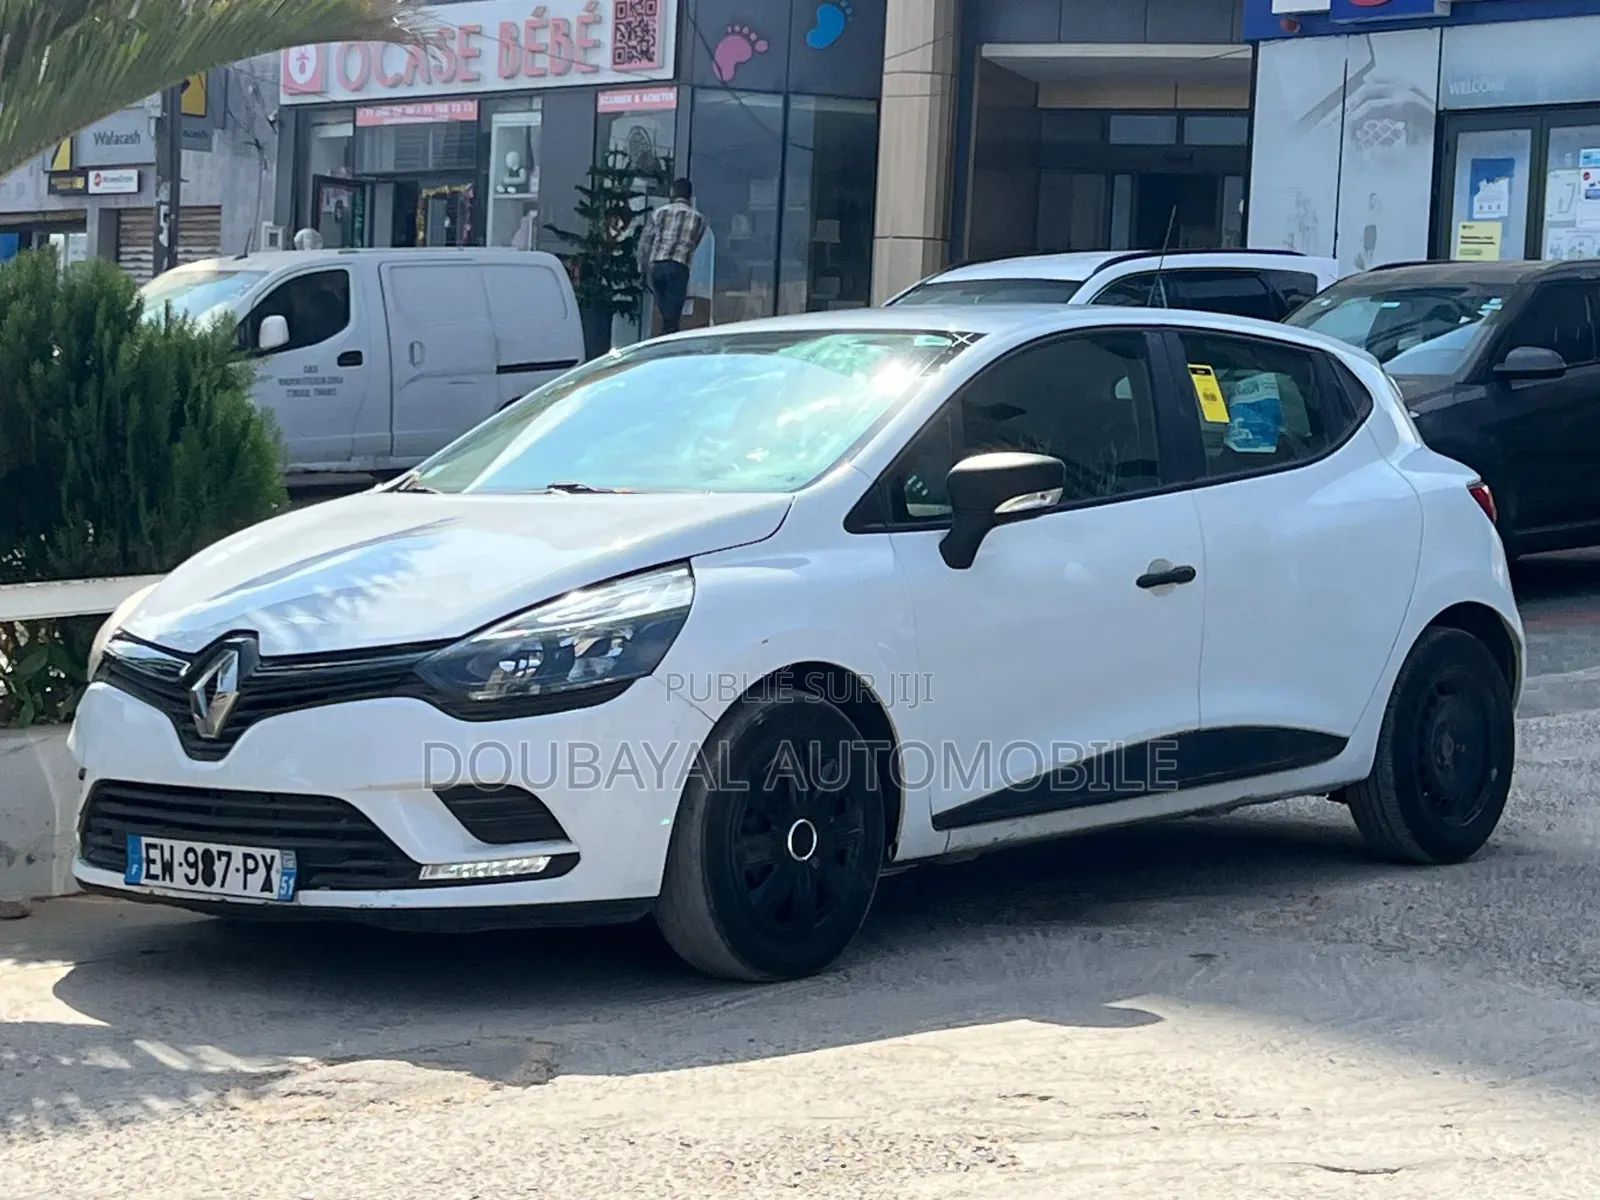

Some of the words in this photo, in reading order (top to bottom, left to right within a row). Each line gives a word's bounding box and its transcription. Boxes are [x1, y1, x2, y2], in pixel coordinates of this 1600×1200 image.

[335, 24, 483, 92] OCASE
[497, 1, 601, 79] BÉBÉ
[279, 875, 294, 896] 51
